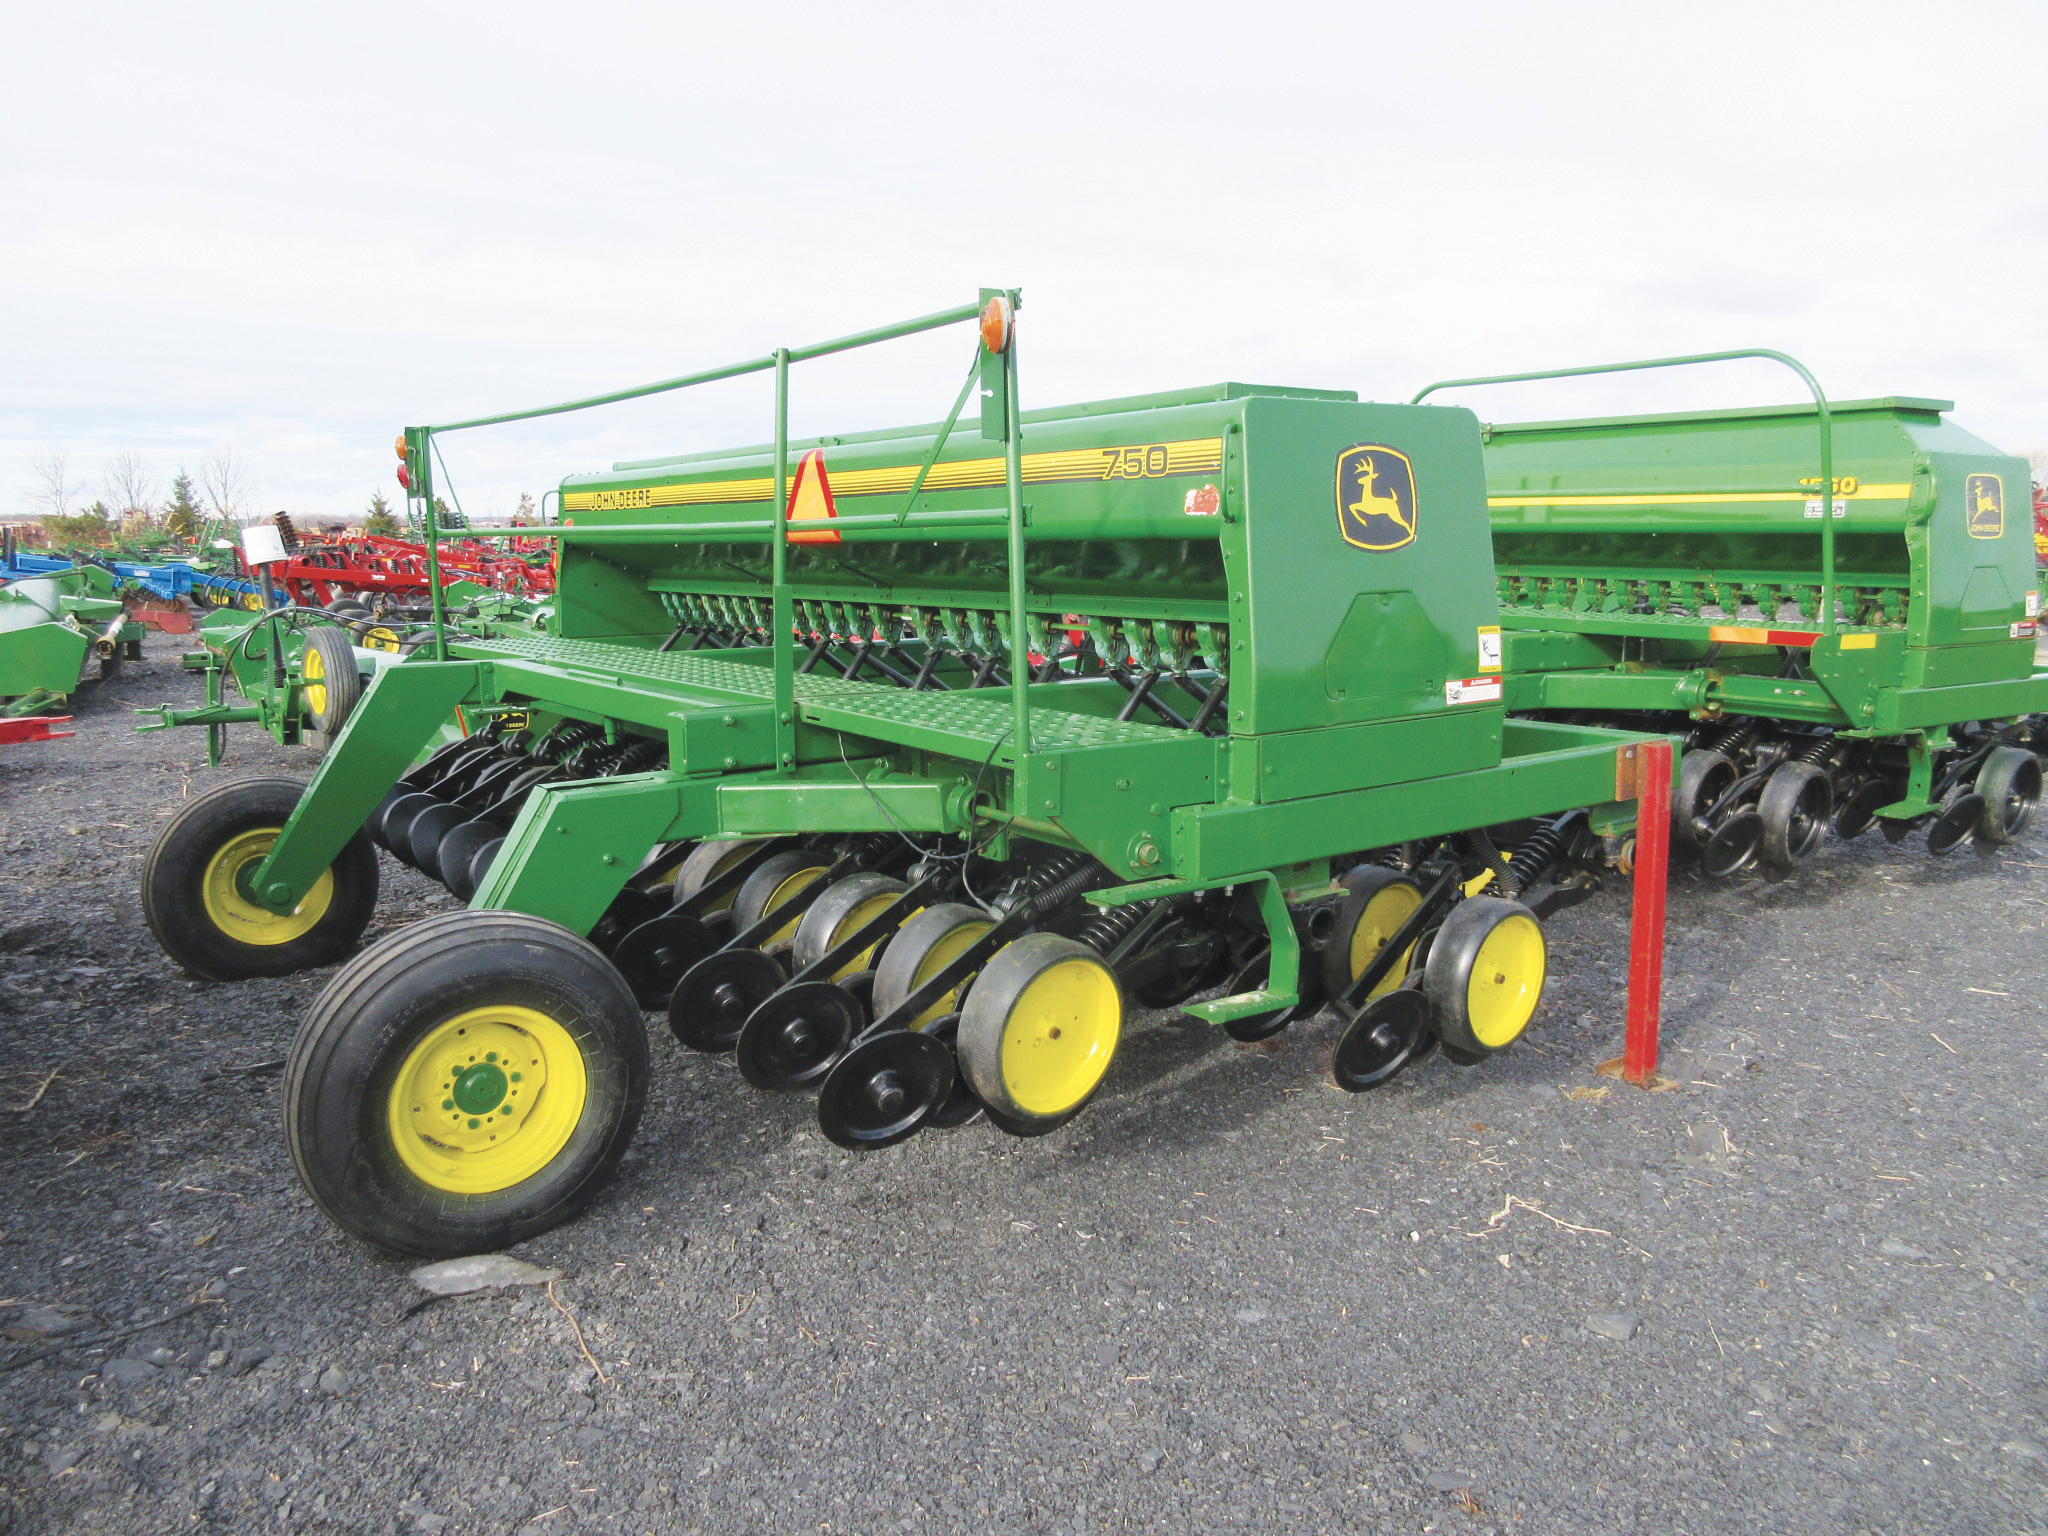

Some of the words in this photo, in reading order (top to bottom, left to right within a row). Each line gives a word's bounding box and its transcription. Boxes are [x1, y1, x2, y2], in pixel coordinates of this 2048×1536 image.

[1102, 446, 1168, 479] 750
[591, 492, 616, 509] JOHN
[618, 489, 651, 508] DEERE
